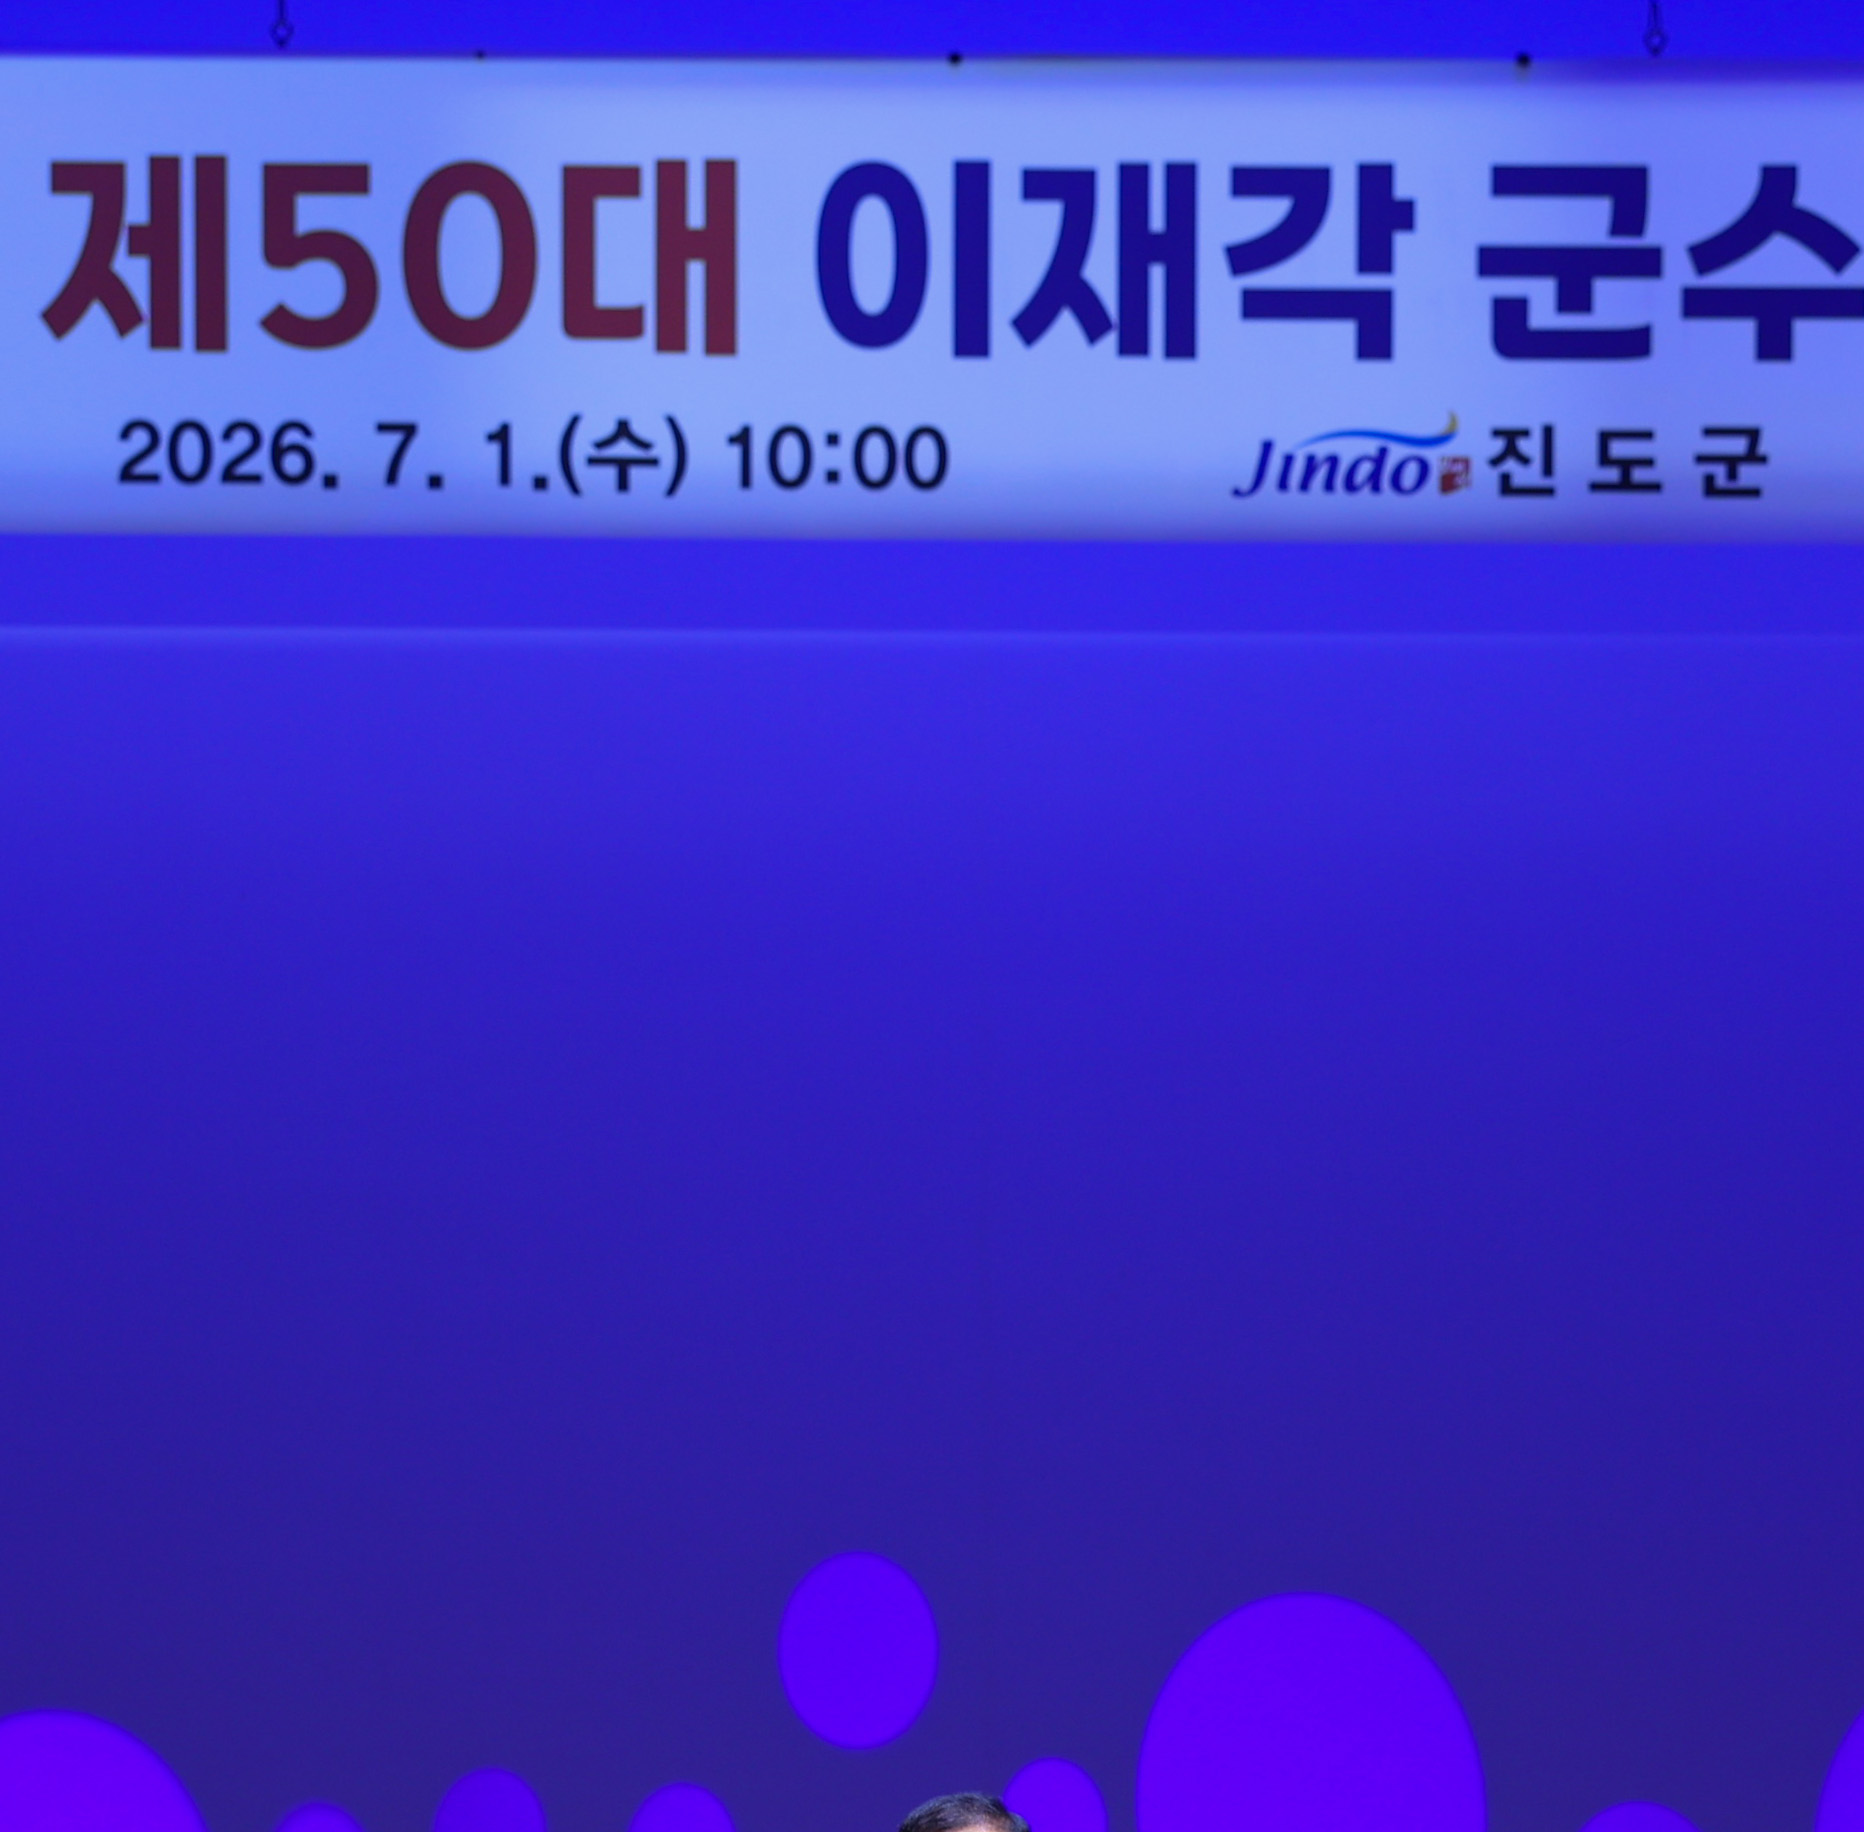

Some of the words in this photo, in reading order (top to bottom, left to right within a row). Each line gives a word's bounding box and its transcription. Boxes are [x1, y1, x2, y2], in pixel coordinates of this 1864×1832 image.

[40, 153, 738, 356] 제50대
[815, 159, 1416, 362] 이재각
[118, 419, 339, 491] 2026.
[375, 422, 444, 491] 7.
[727, 424, 949, 491] 10:00
[1233, 439, 1430, 497] Jindo
